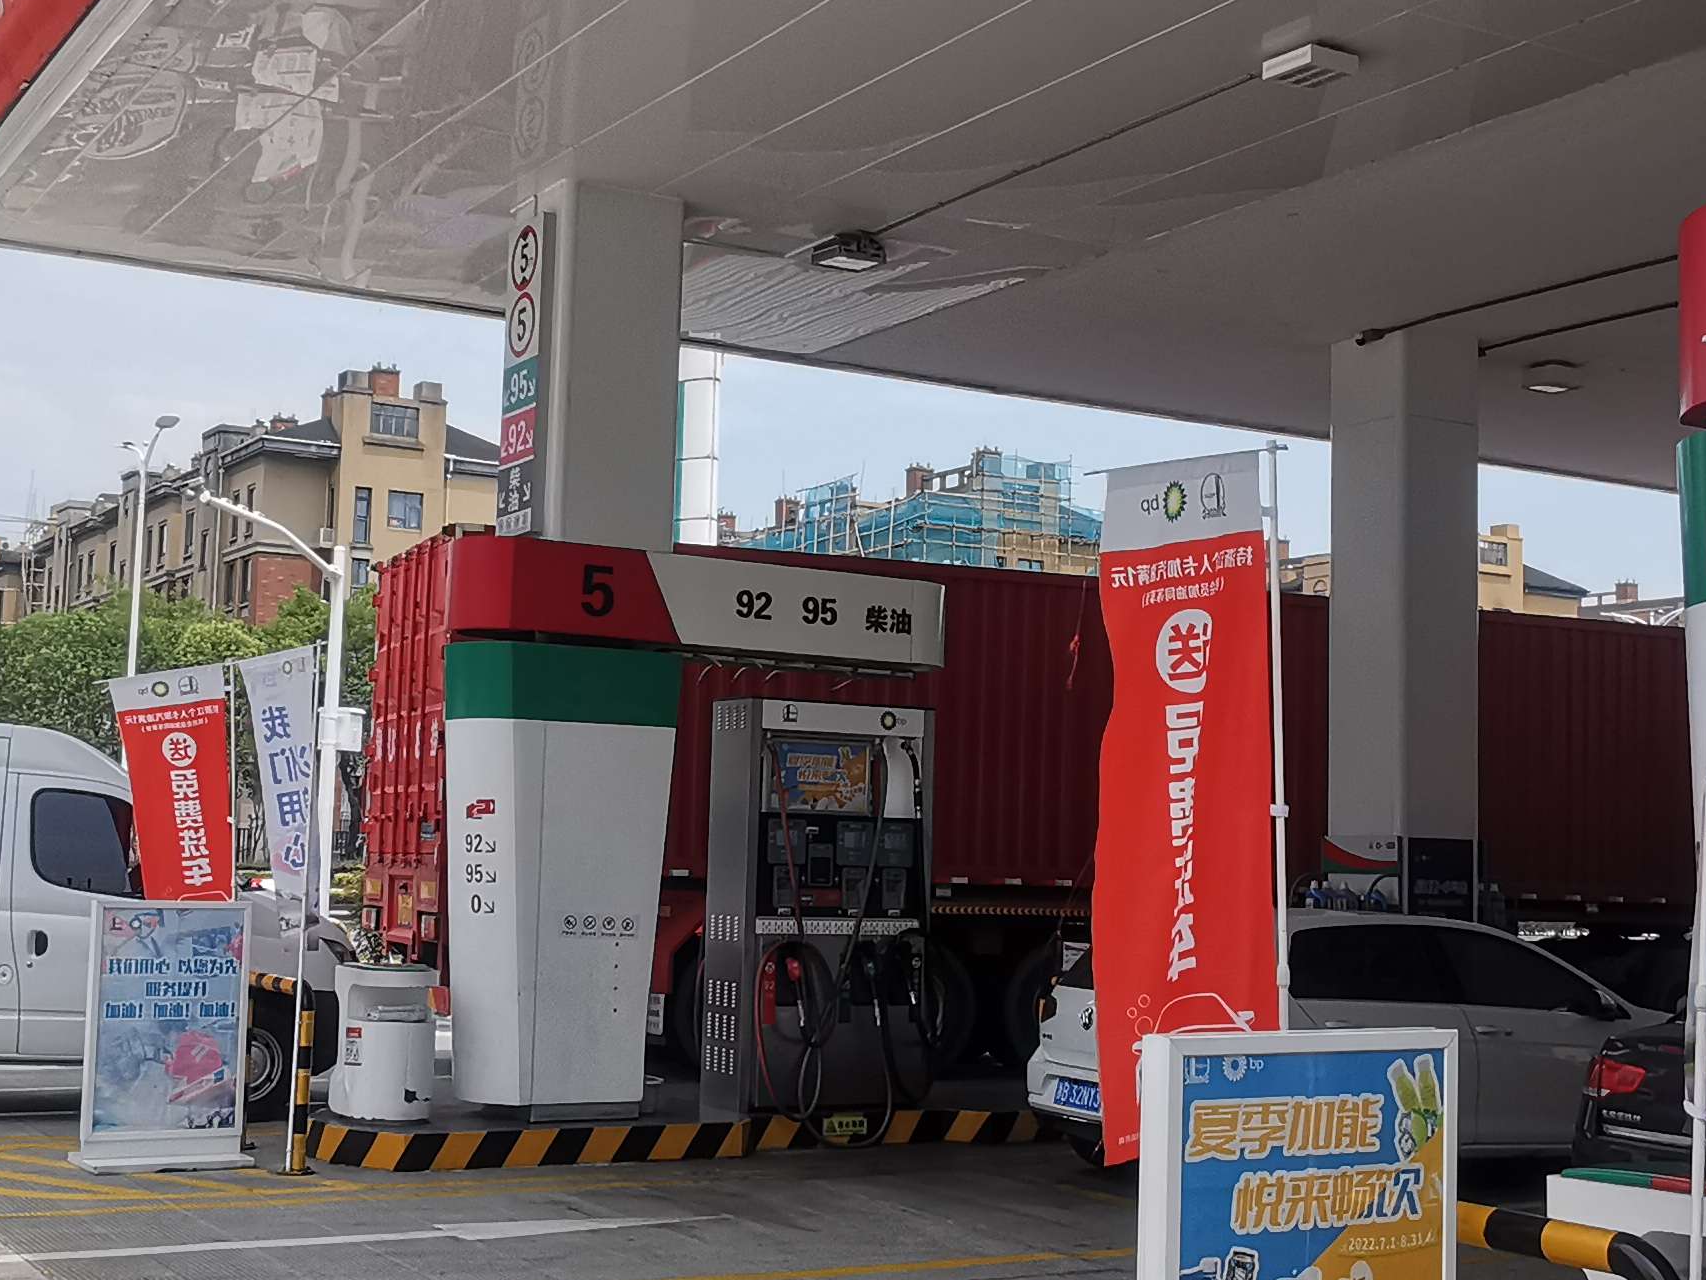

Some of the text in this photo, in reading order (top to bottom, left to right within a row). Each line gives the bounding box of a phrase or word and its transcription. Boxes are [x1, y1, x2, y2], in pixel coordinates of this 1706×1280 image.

[516, 307, 527, 342] 5
[510, 369, 528, 406] 95
[507, 420, 525, 460] 92
[508, 466, 521, 513] 柴油
[580, 563, 615, 618] 5
[735, 589, 912, 636] 92 95 柴油
[465, 833, 485, 853] 92
[465, 864, 485, 883] 95
[470, 895, 482, 915] 0
[1249, 1056, 1264, 1071] bp
[1187, 1096, 1383, 1159] 夏季加能
[1233, 1167, 1423, 1230] 悦来畅饮
